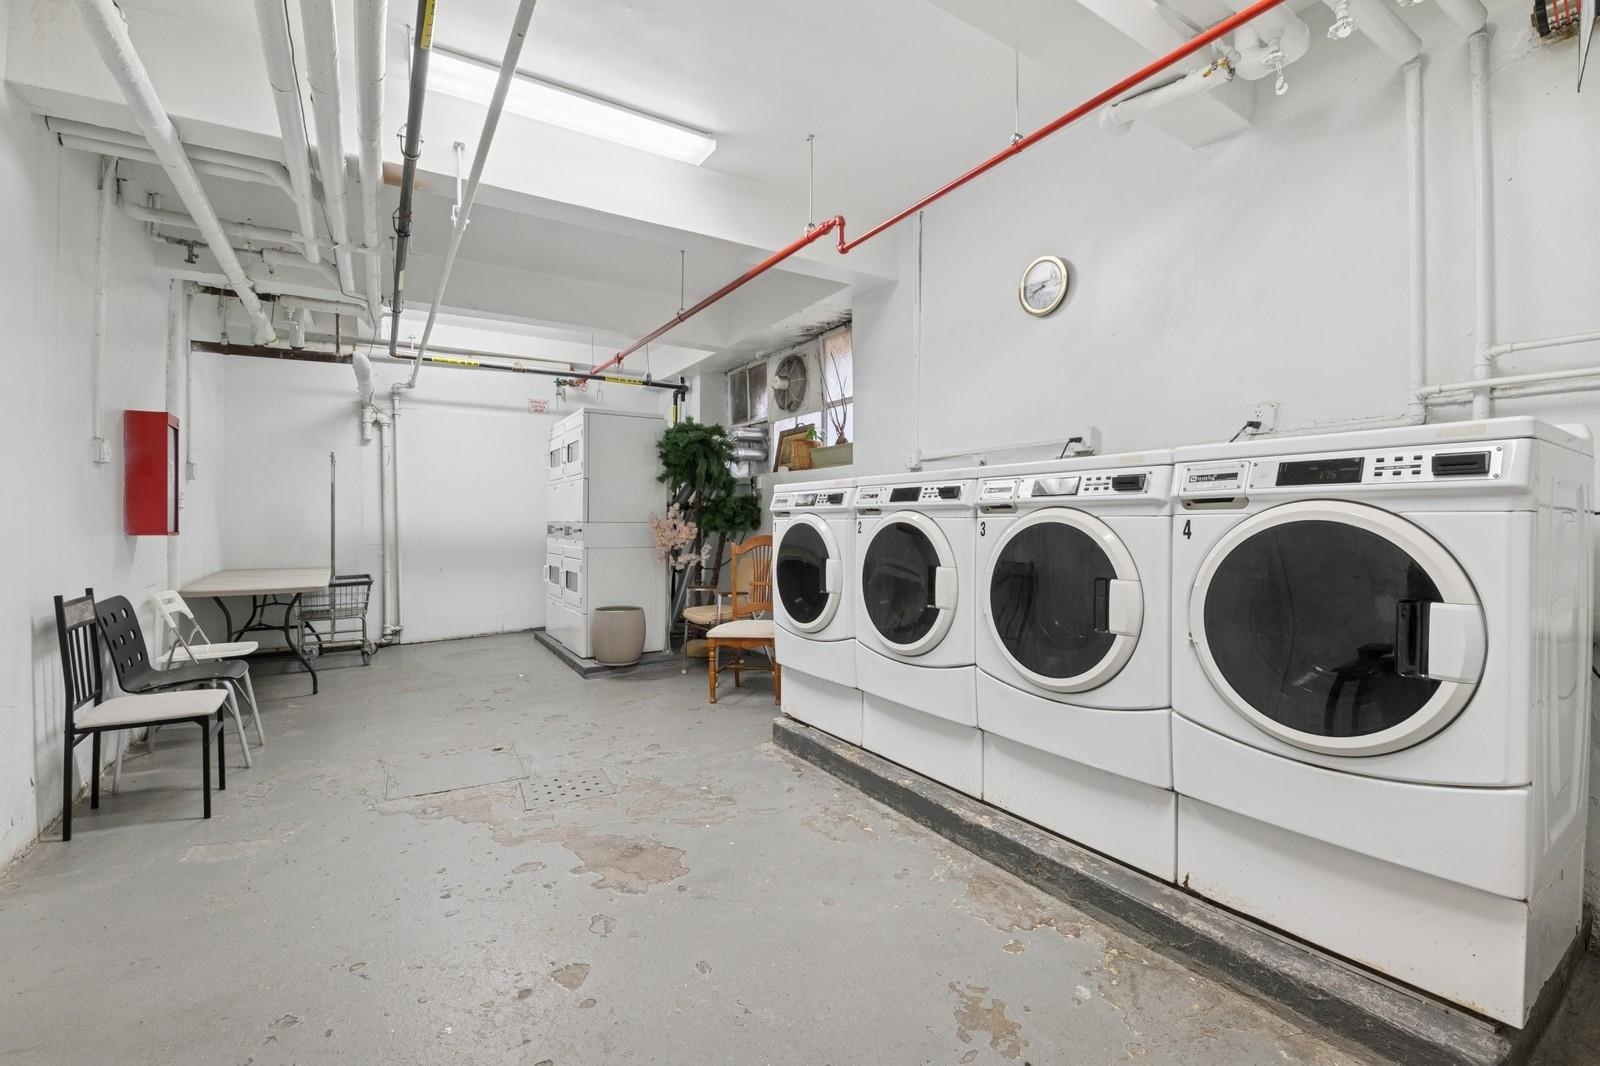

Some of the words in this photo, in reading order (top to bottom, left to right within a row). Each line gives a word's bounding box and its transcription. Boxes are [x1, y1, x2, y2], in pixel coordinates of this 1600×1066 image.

[857, 521, 862, 534] 2
[980, 521, 986, 537] 3
[1182, 519, 1192, 540] 4
